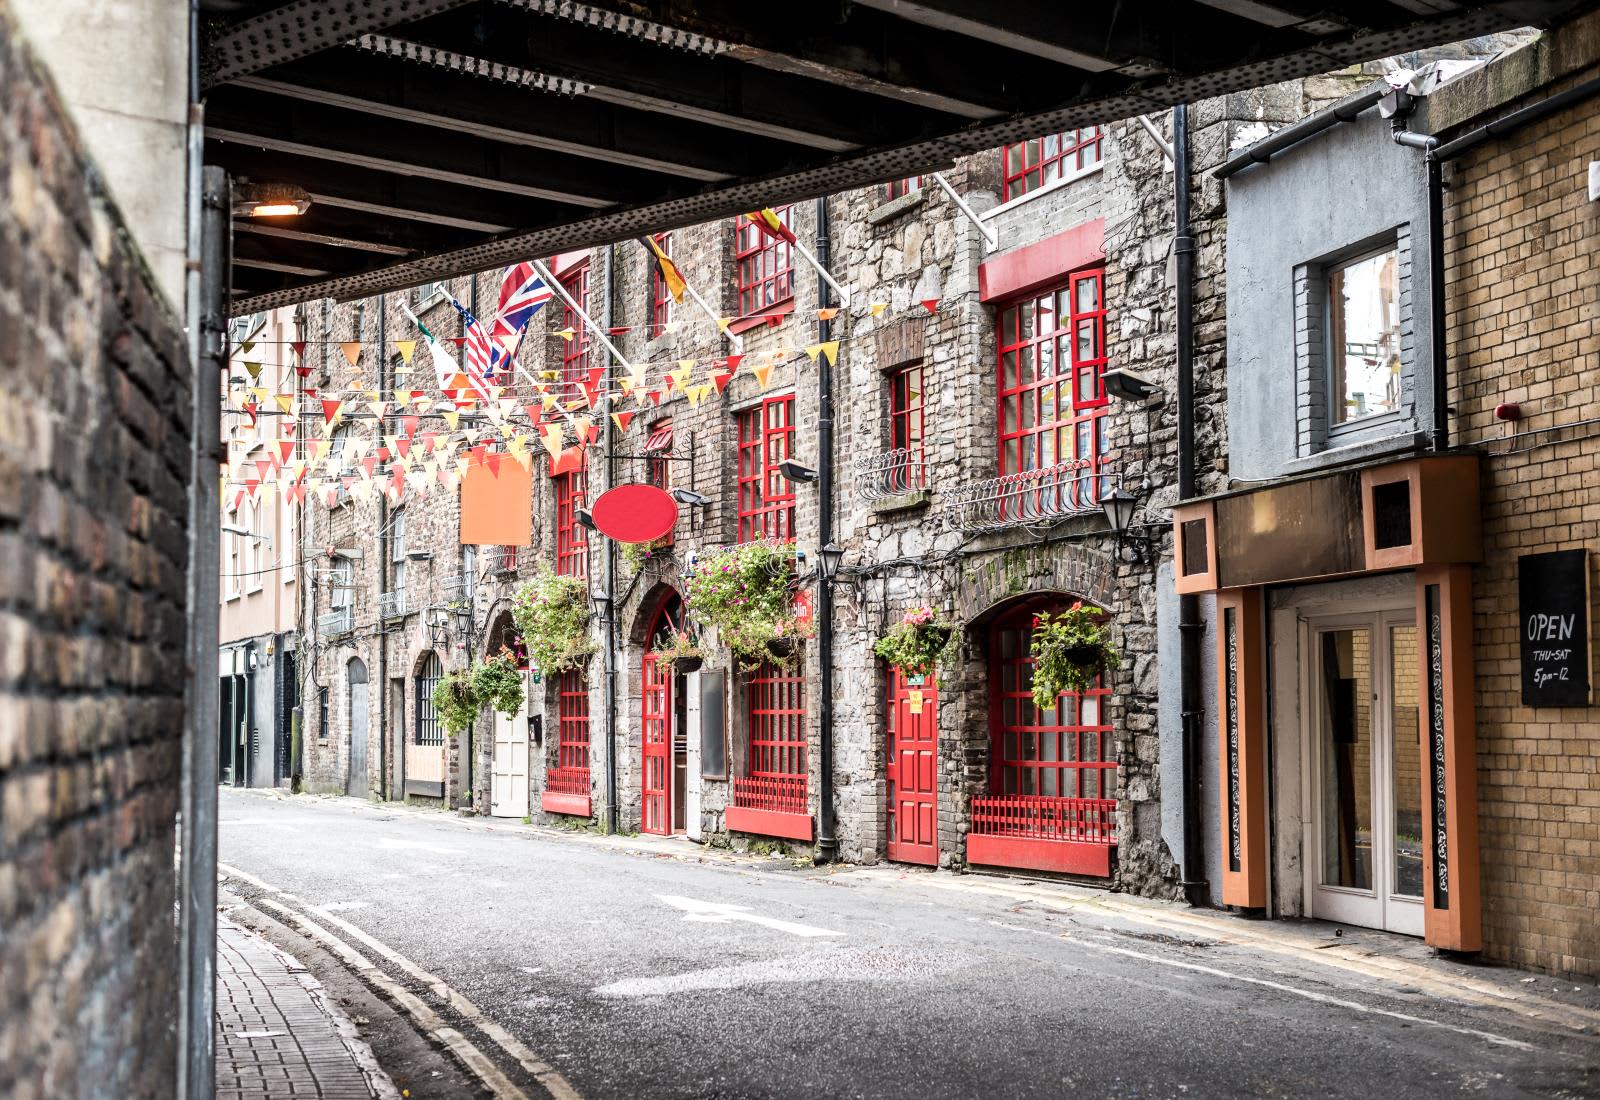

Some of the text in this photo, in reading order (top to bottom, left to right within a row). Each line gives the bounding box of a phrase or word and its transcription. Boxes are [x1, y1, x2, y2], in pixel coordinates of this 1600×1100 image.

[1528, 613, 1575, 641] OPEN
[1533, 649, 1572, 662] THU-SAT
[1533, 667, 1569, 689] 5pm-12
